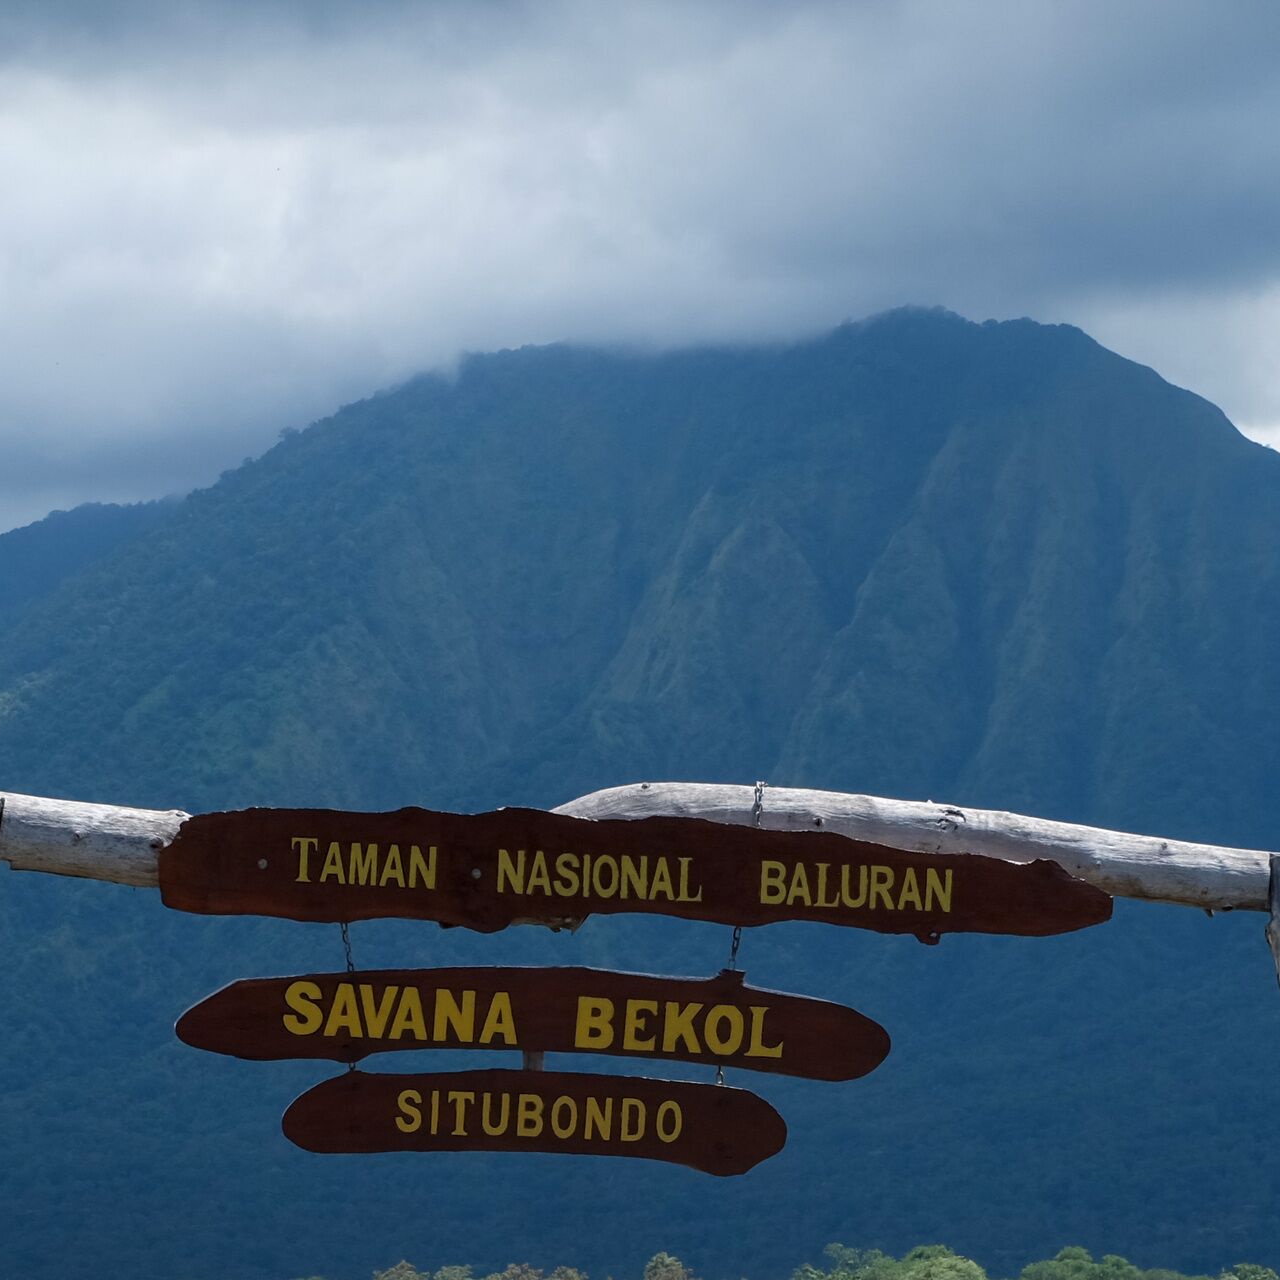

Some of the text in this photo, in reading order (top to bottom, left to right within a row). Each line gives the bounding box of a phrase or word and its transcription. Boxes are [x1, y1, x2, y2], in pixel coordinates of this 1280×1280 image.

[290, 836, 954, 913] TAMAN NASIONAL BALURAN
[283, 981, 783, 1059] SAVANA BEKOL
[395, 1089, 683, 1143] SITUBONDO
